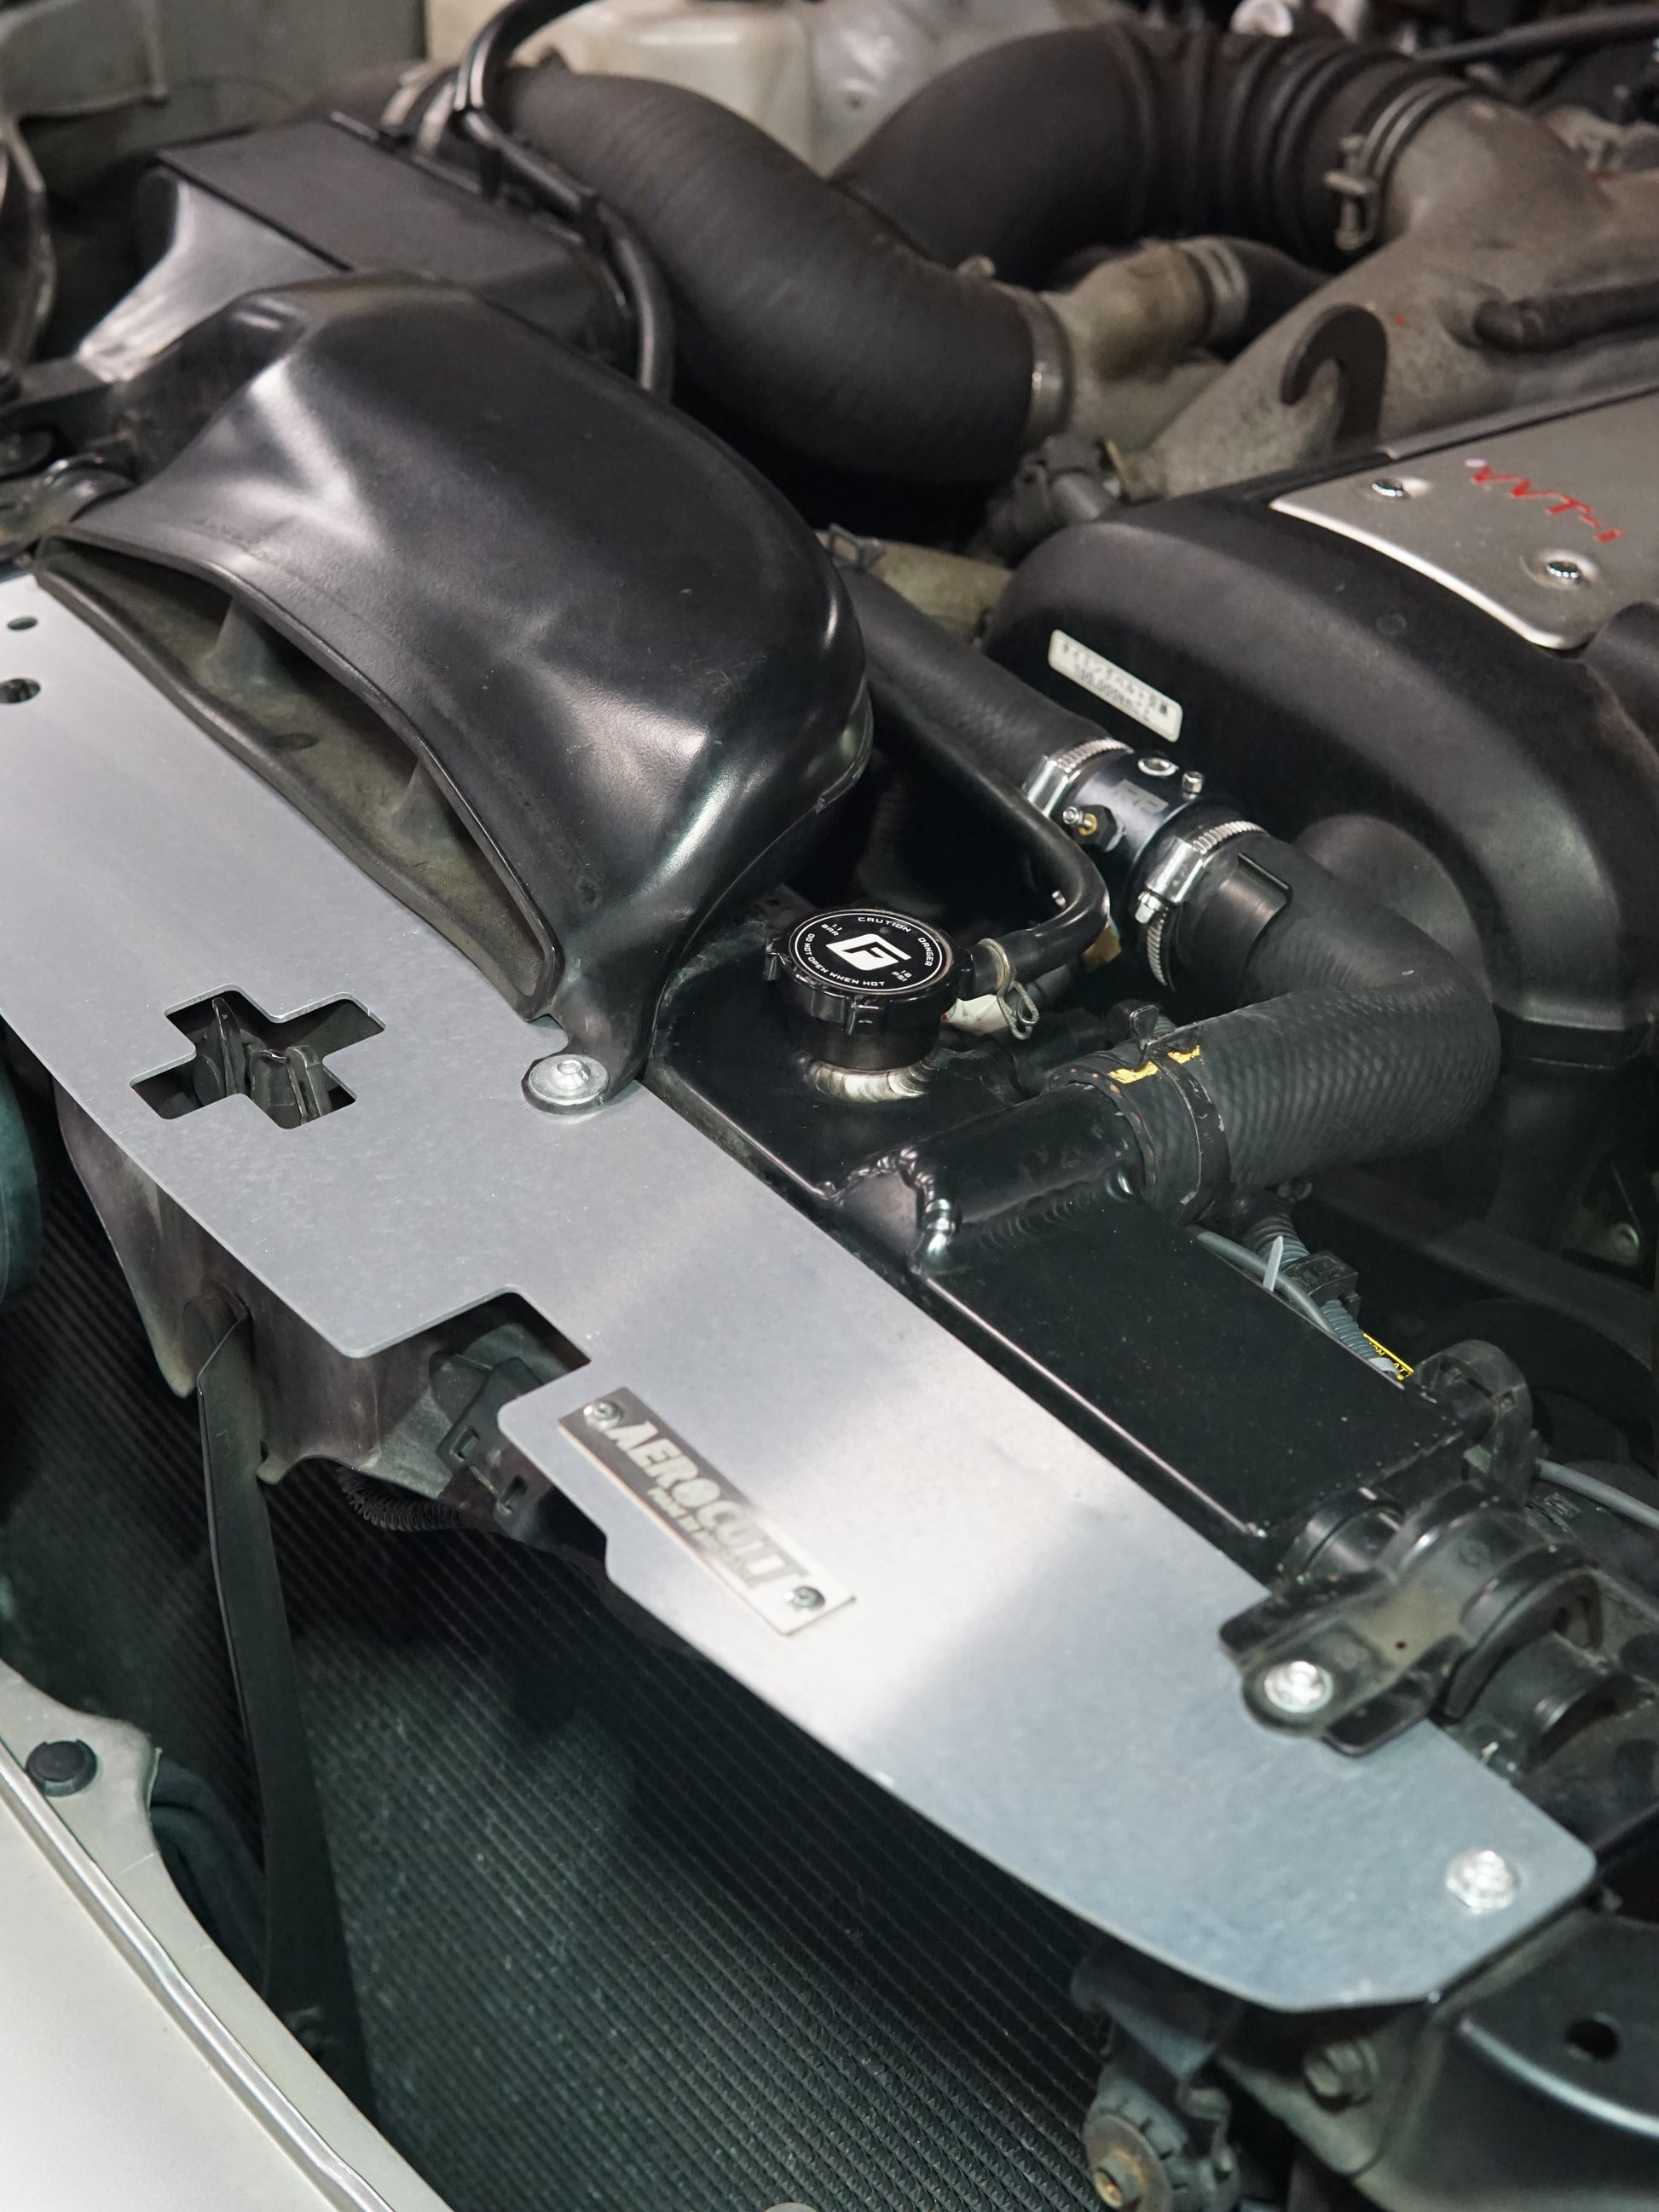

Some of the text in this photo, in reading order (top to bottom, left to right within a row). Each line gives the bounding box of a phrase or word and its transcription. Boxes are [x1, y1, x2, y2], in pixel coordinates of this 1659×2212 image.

[820, 923, 840, 937] BAR
[832, 923, 843, 932] 1.1
[858, 916, 912, 933] CAUTION
[806, 933, 816, 943] DO
[803, 942, 812, 956] NOT
[917, 937, 934, 967] DANGER
[807, 956, 830, 973] OPEN
[830, 971, 860, 985] WHEN
[891, 970, 909, 982] PSI
